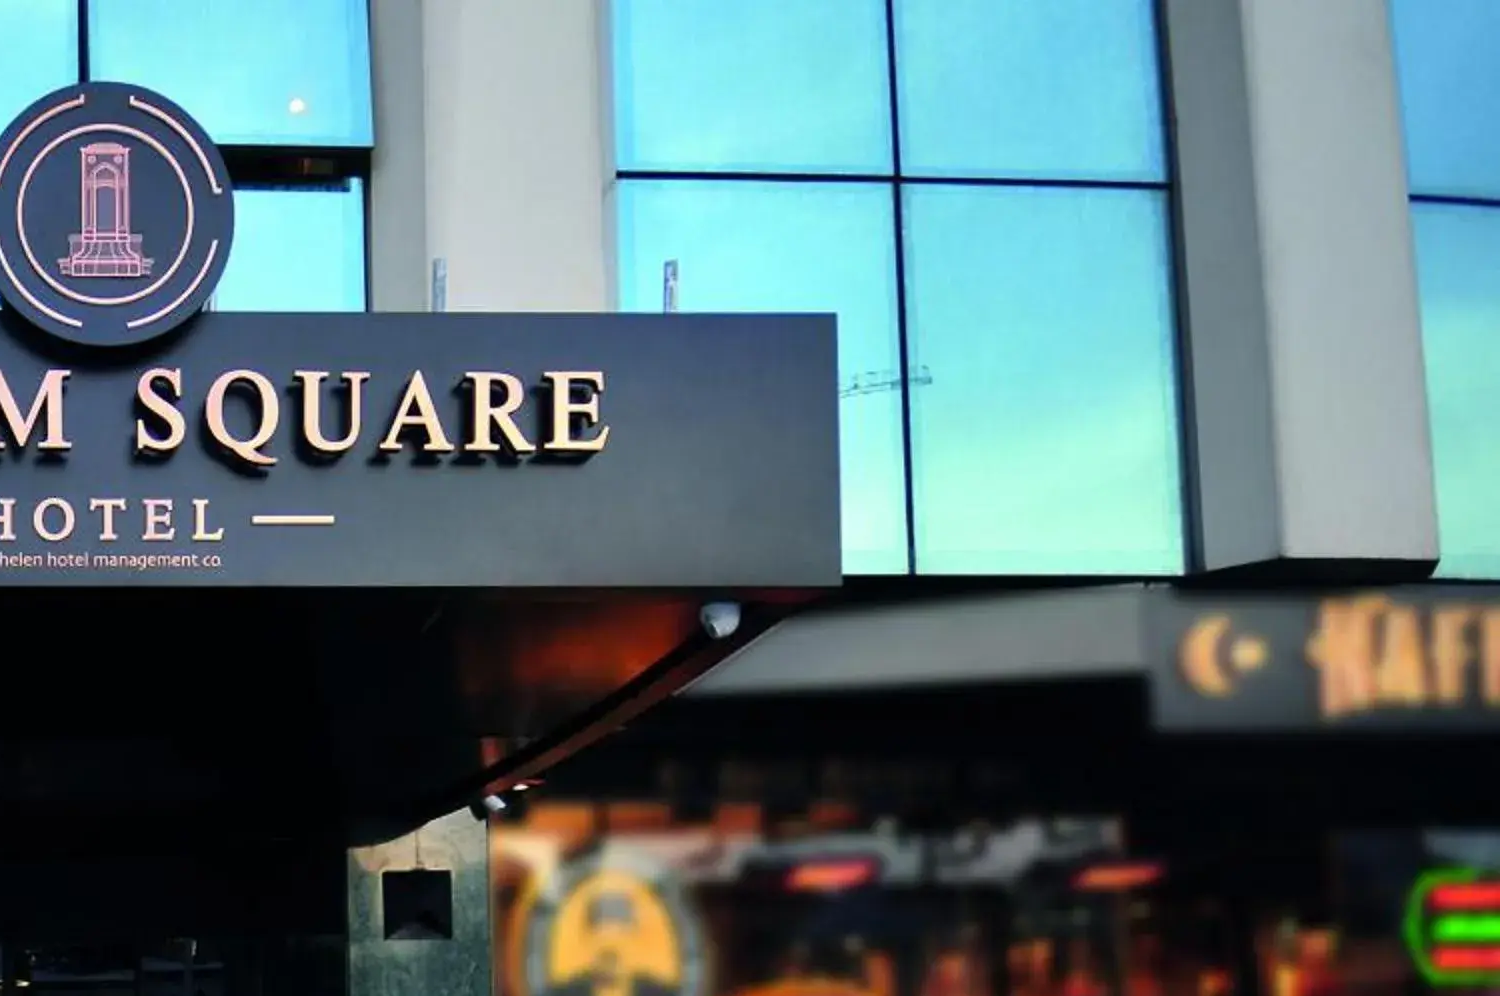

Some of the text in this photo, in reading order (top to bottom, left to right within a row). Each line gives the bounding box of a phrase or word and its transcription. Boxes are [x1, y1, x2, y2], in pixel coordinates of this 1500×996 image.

[136, 367, 611, 467] SQUARE
[0, 551, 43, 568] helen
[47, 551, 89, 568] hotel
[93, 553, 200, 571] management
